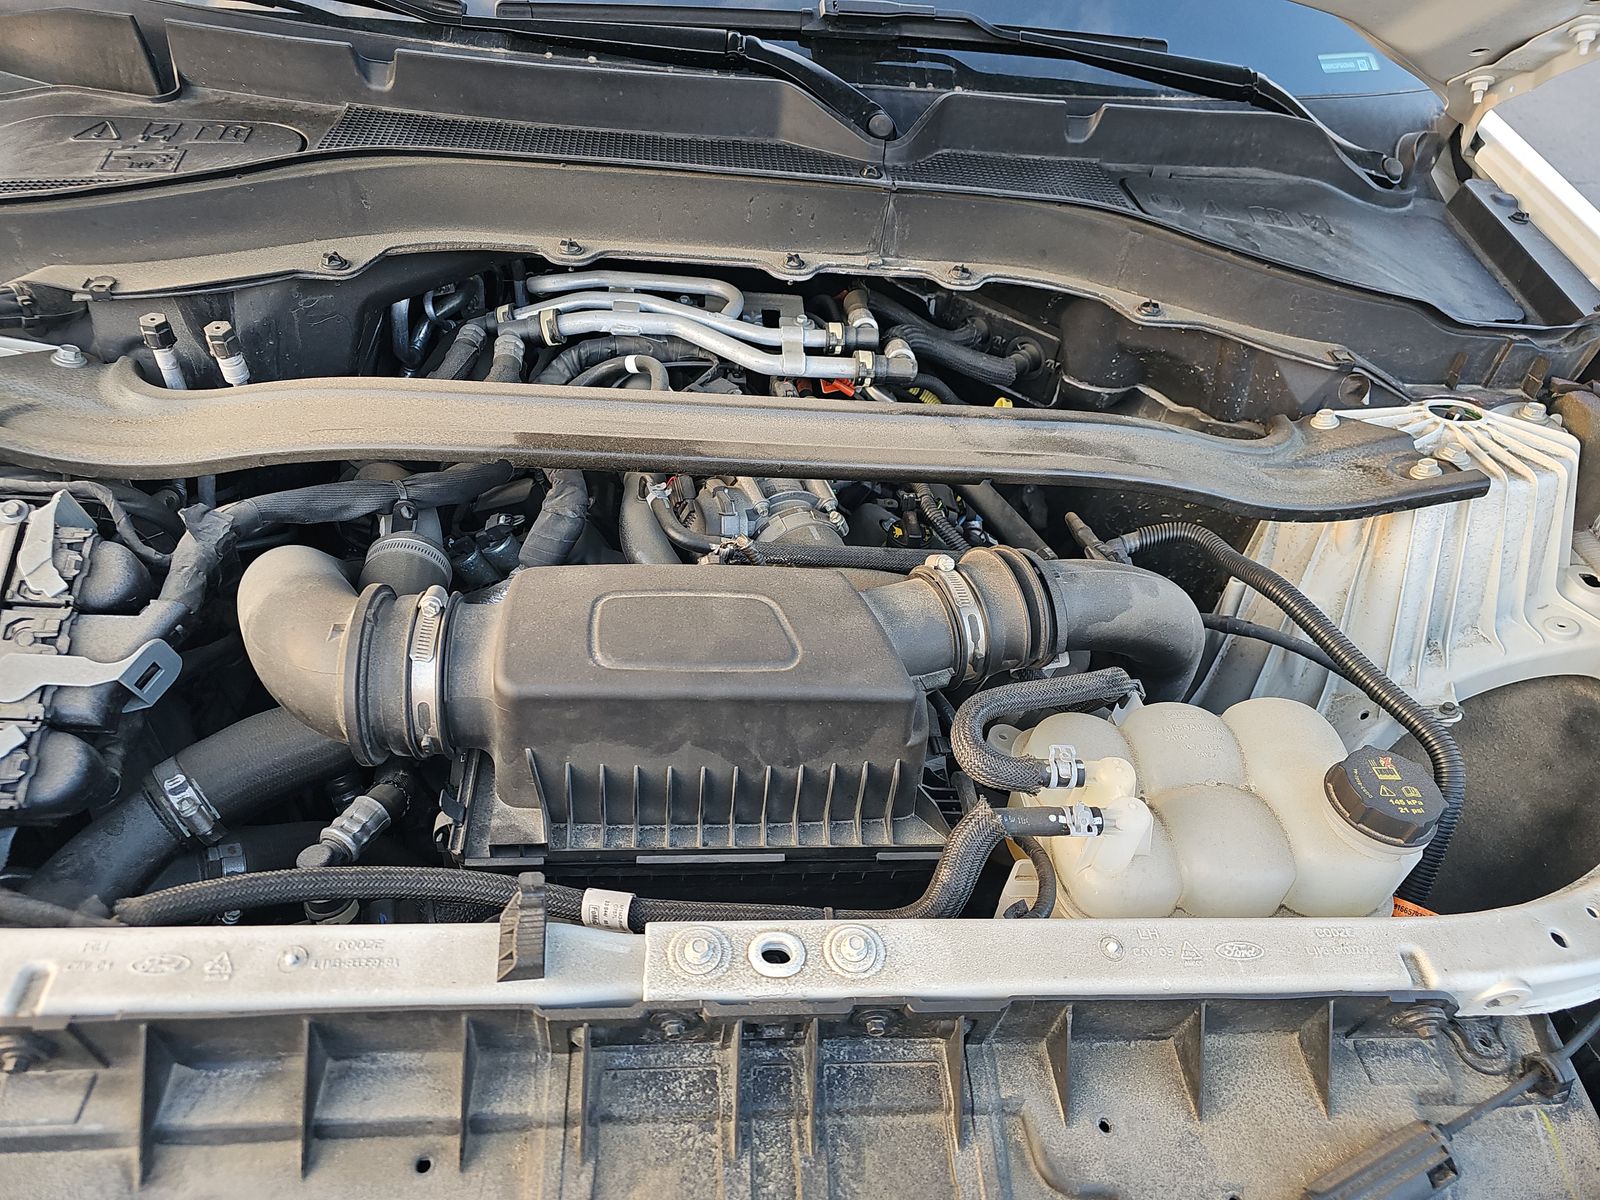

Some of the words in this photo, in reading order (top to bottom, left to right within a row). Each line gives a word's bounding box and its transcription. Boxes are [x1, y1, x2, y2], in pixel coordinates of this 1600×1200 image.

[1411, 807, 1425, 815] psi
[1136, 927, 1160, 941] LH
[1221, 943, 1259, 958] Ford
